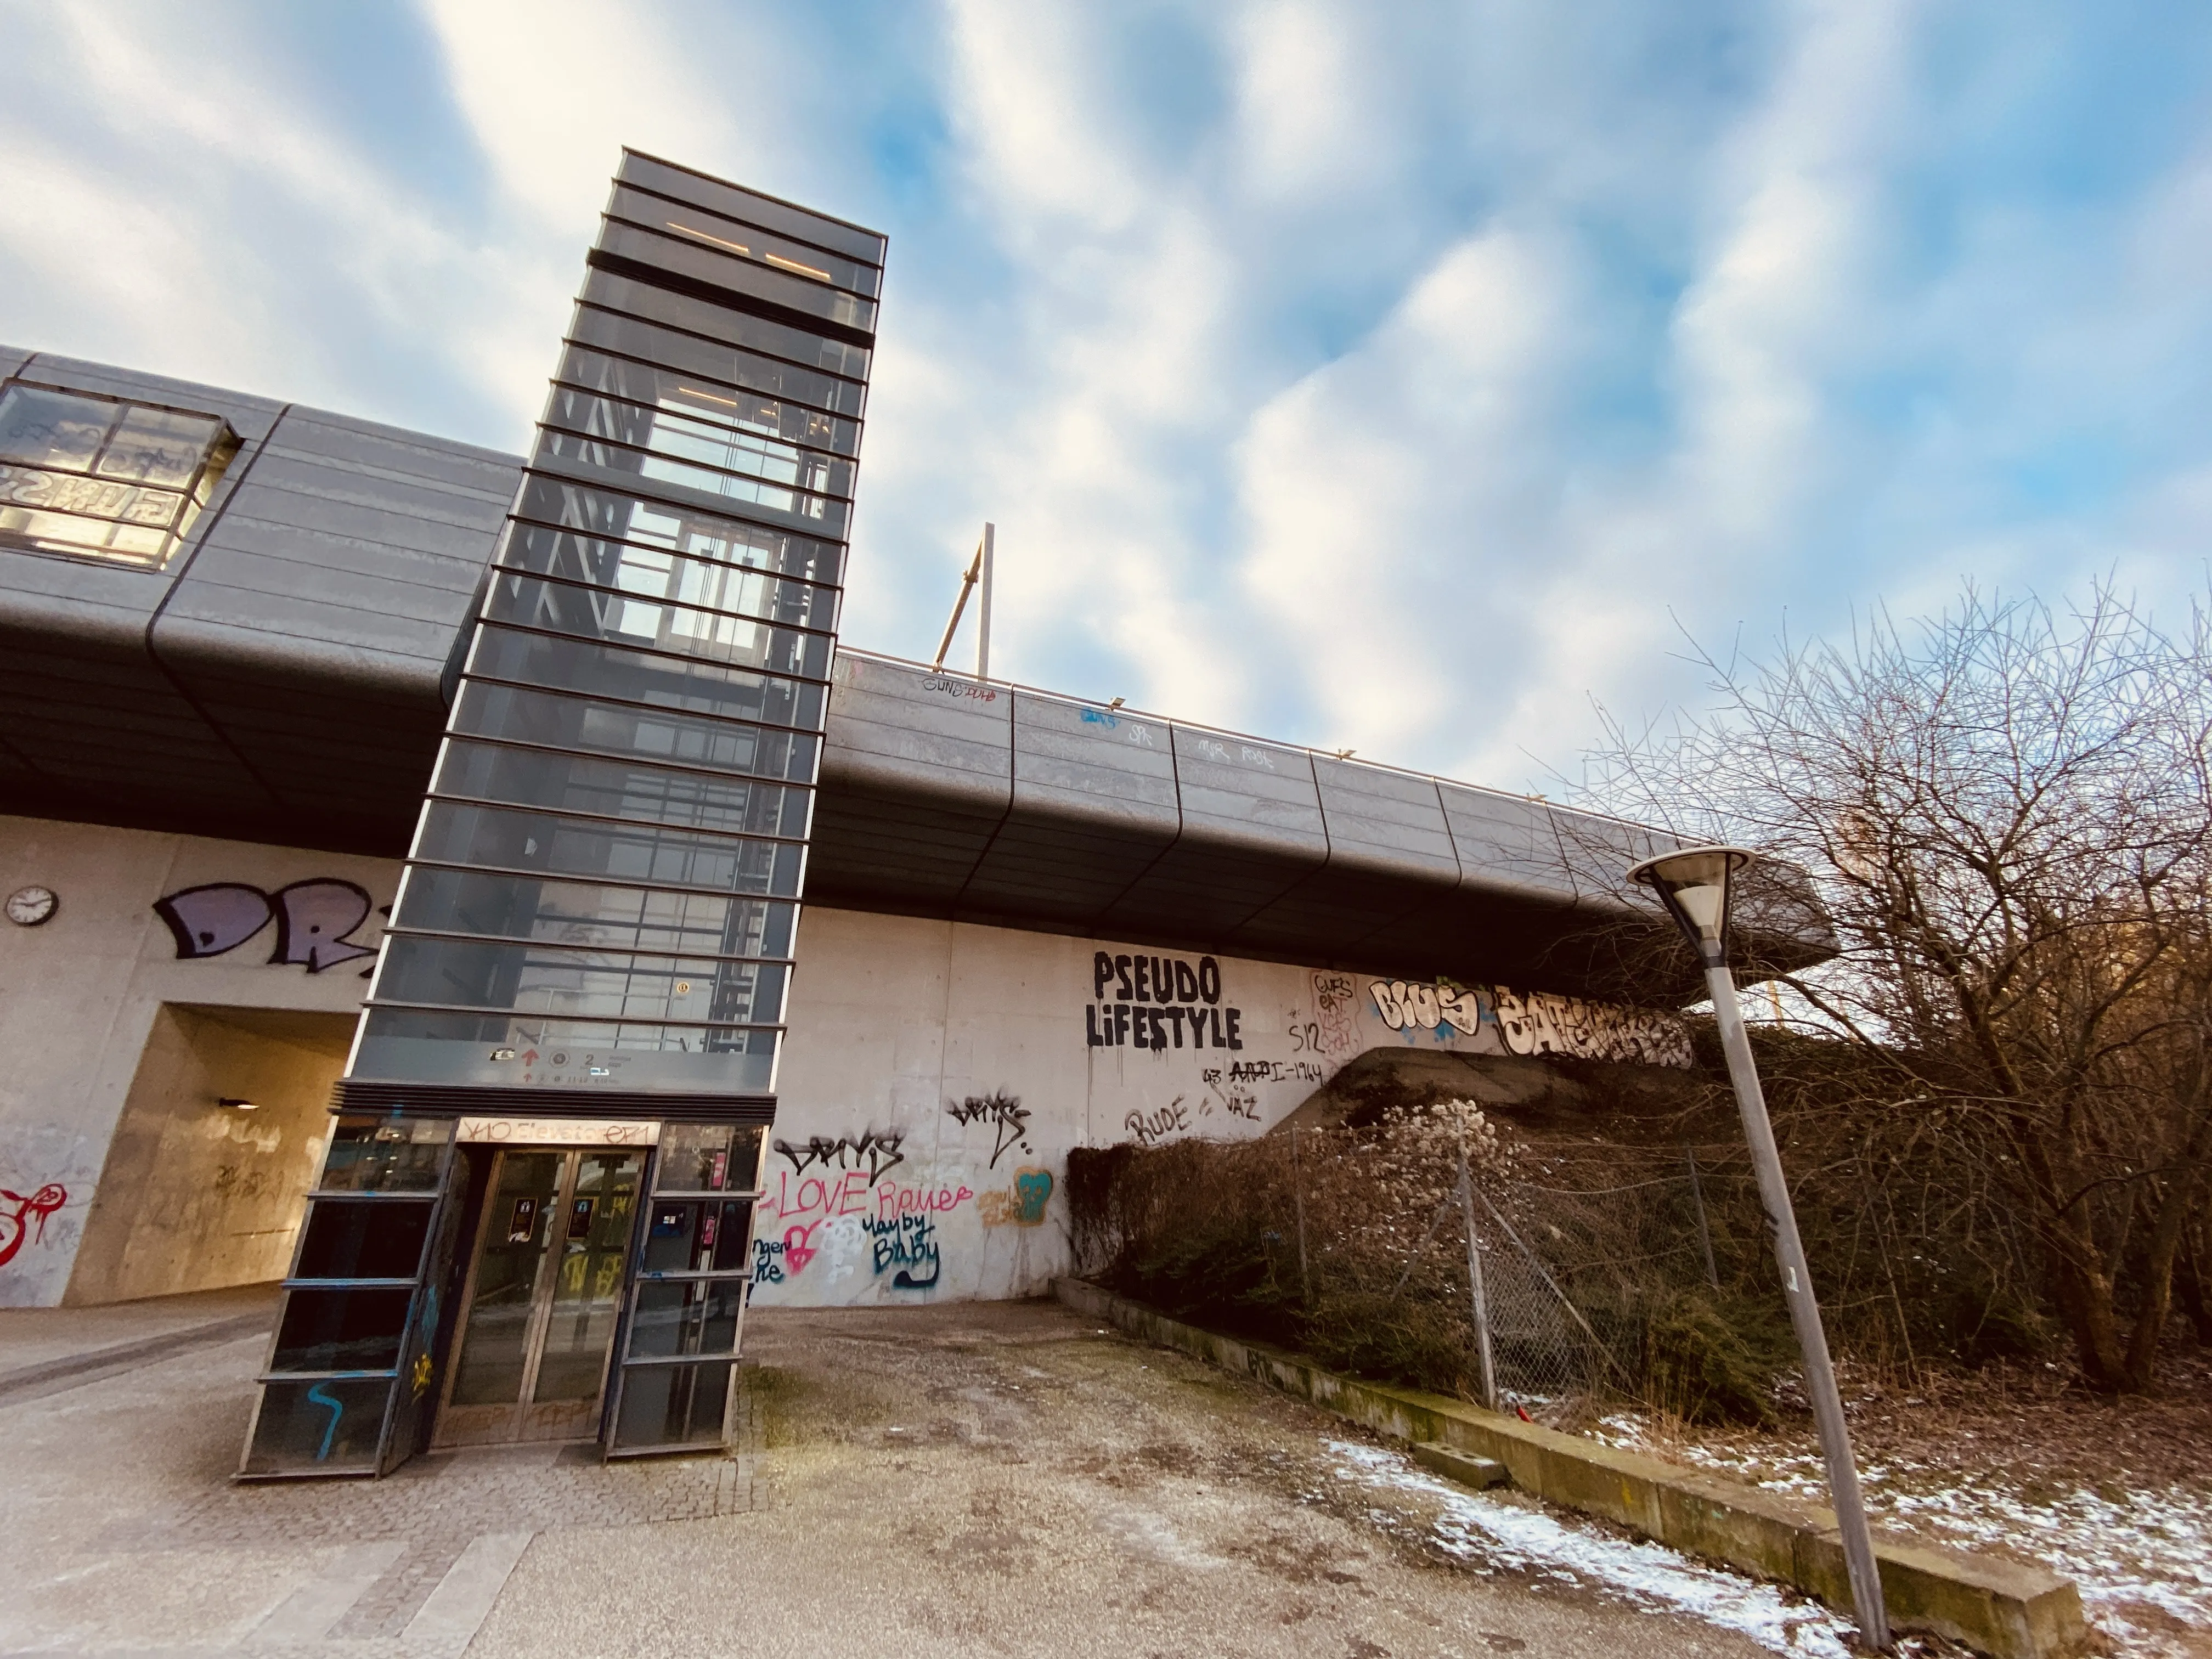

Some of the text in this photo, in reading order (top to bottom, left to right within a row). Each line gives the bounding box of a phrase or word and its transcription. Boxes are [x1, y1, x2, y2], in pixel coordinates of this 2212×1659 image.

[1094, 951, 1220, 1005] PSEUDO
[1125, 1095, 1192, 1147] RUDE
[779, 1171, 869, 1219] LOVE
[873, 1235, 941, 1289] Baby
